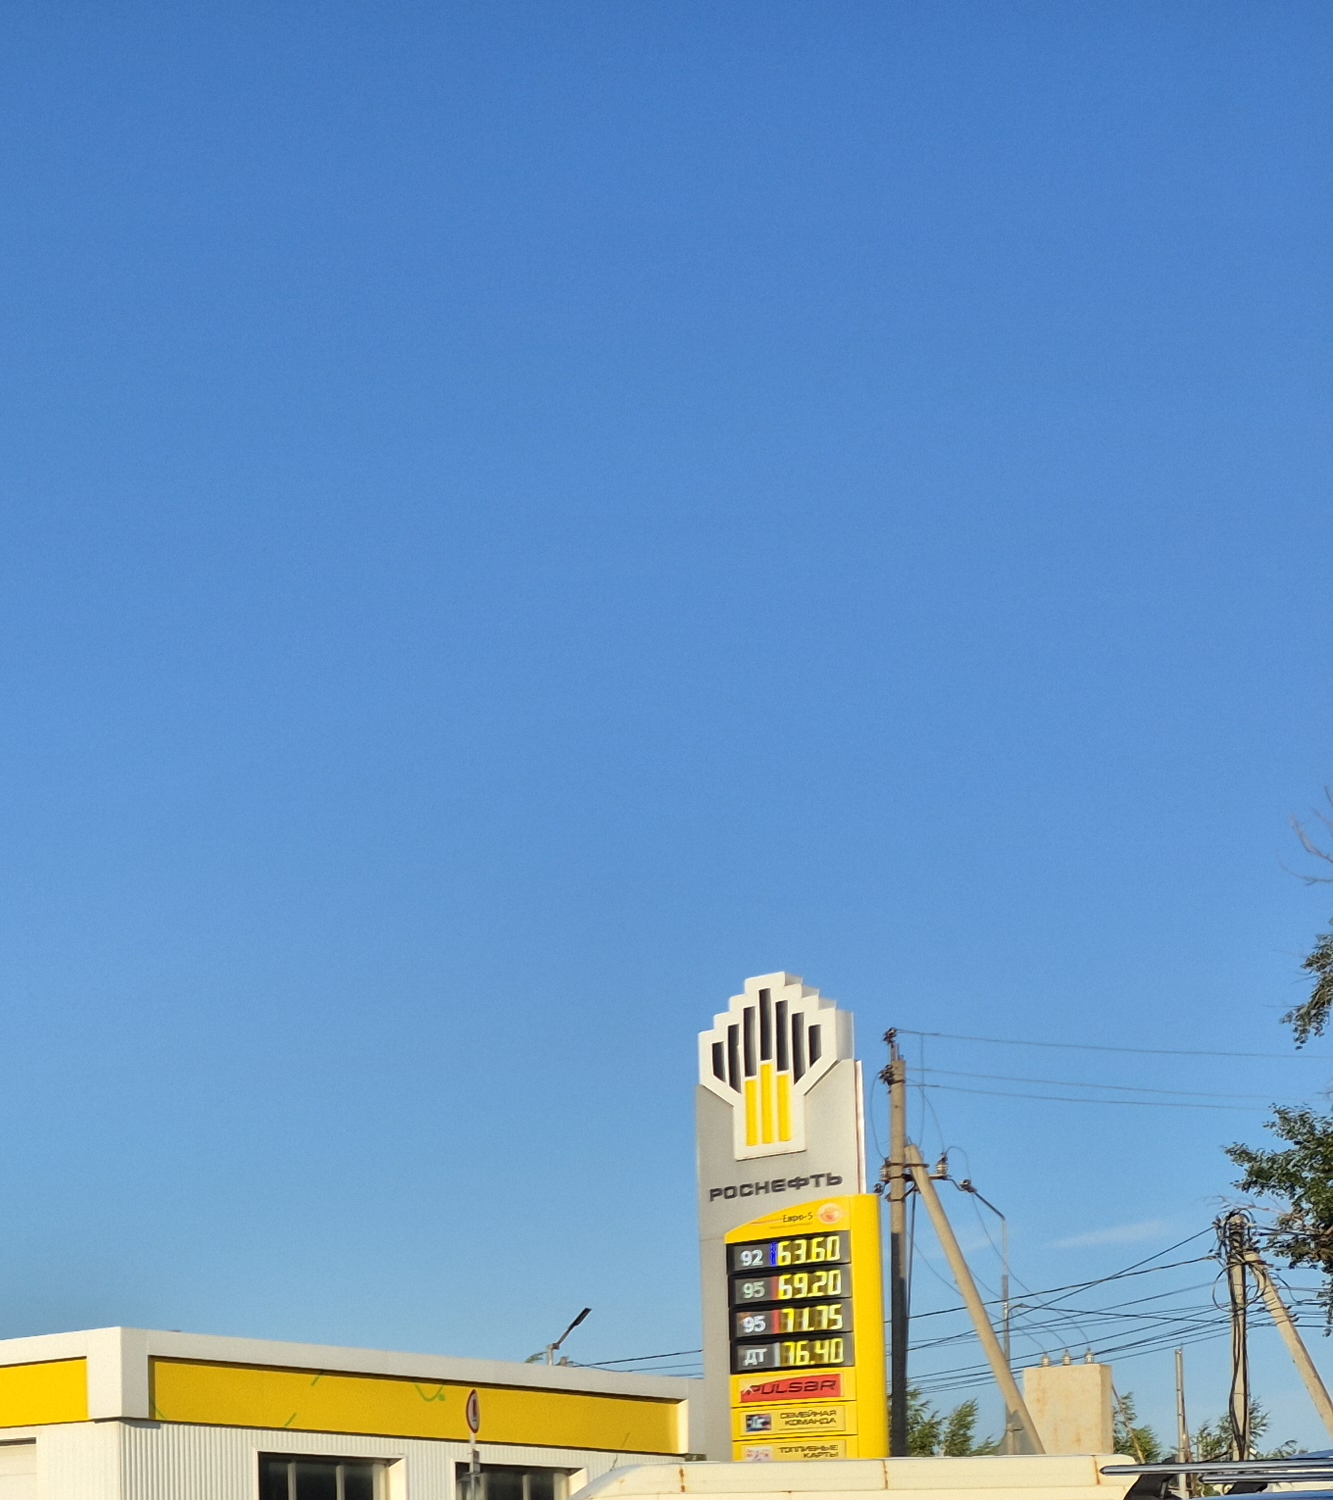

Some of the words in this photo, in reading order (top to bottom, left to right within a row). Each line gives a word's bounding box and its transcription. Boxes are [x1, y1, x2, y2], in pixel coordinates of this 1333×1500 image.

[709, 1172, 843, 1202] РОСНЕФТЬ
[783, 1212, 814, 1223] Евро-5
[740, 1249, 764, 1267] 92
[777, 1236, 840, 1267] 63.60
[743, 1281, 765, 1299] 95
[778, 1269, 842, 1300] 69.20
[743, 1315, 766, 1333] 95
[781, 1304, 844, 1333] 71.75
[744, 1347, 768, 1366] ДТ
[782, 1337, 845, 1367] 76.40
[780, 1409, 837, 1419] СЕМЕЙНАЯ
[785, 1417, 837, 1426] КОМАНДА
[779, 1444, 839, 1453] ТОПЛИВНЫЕ
[803, 1451, 839, 1459] КАРТЫ
